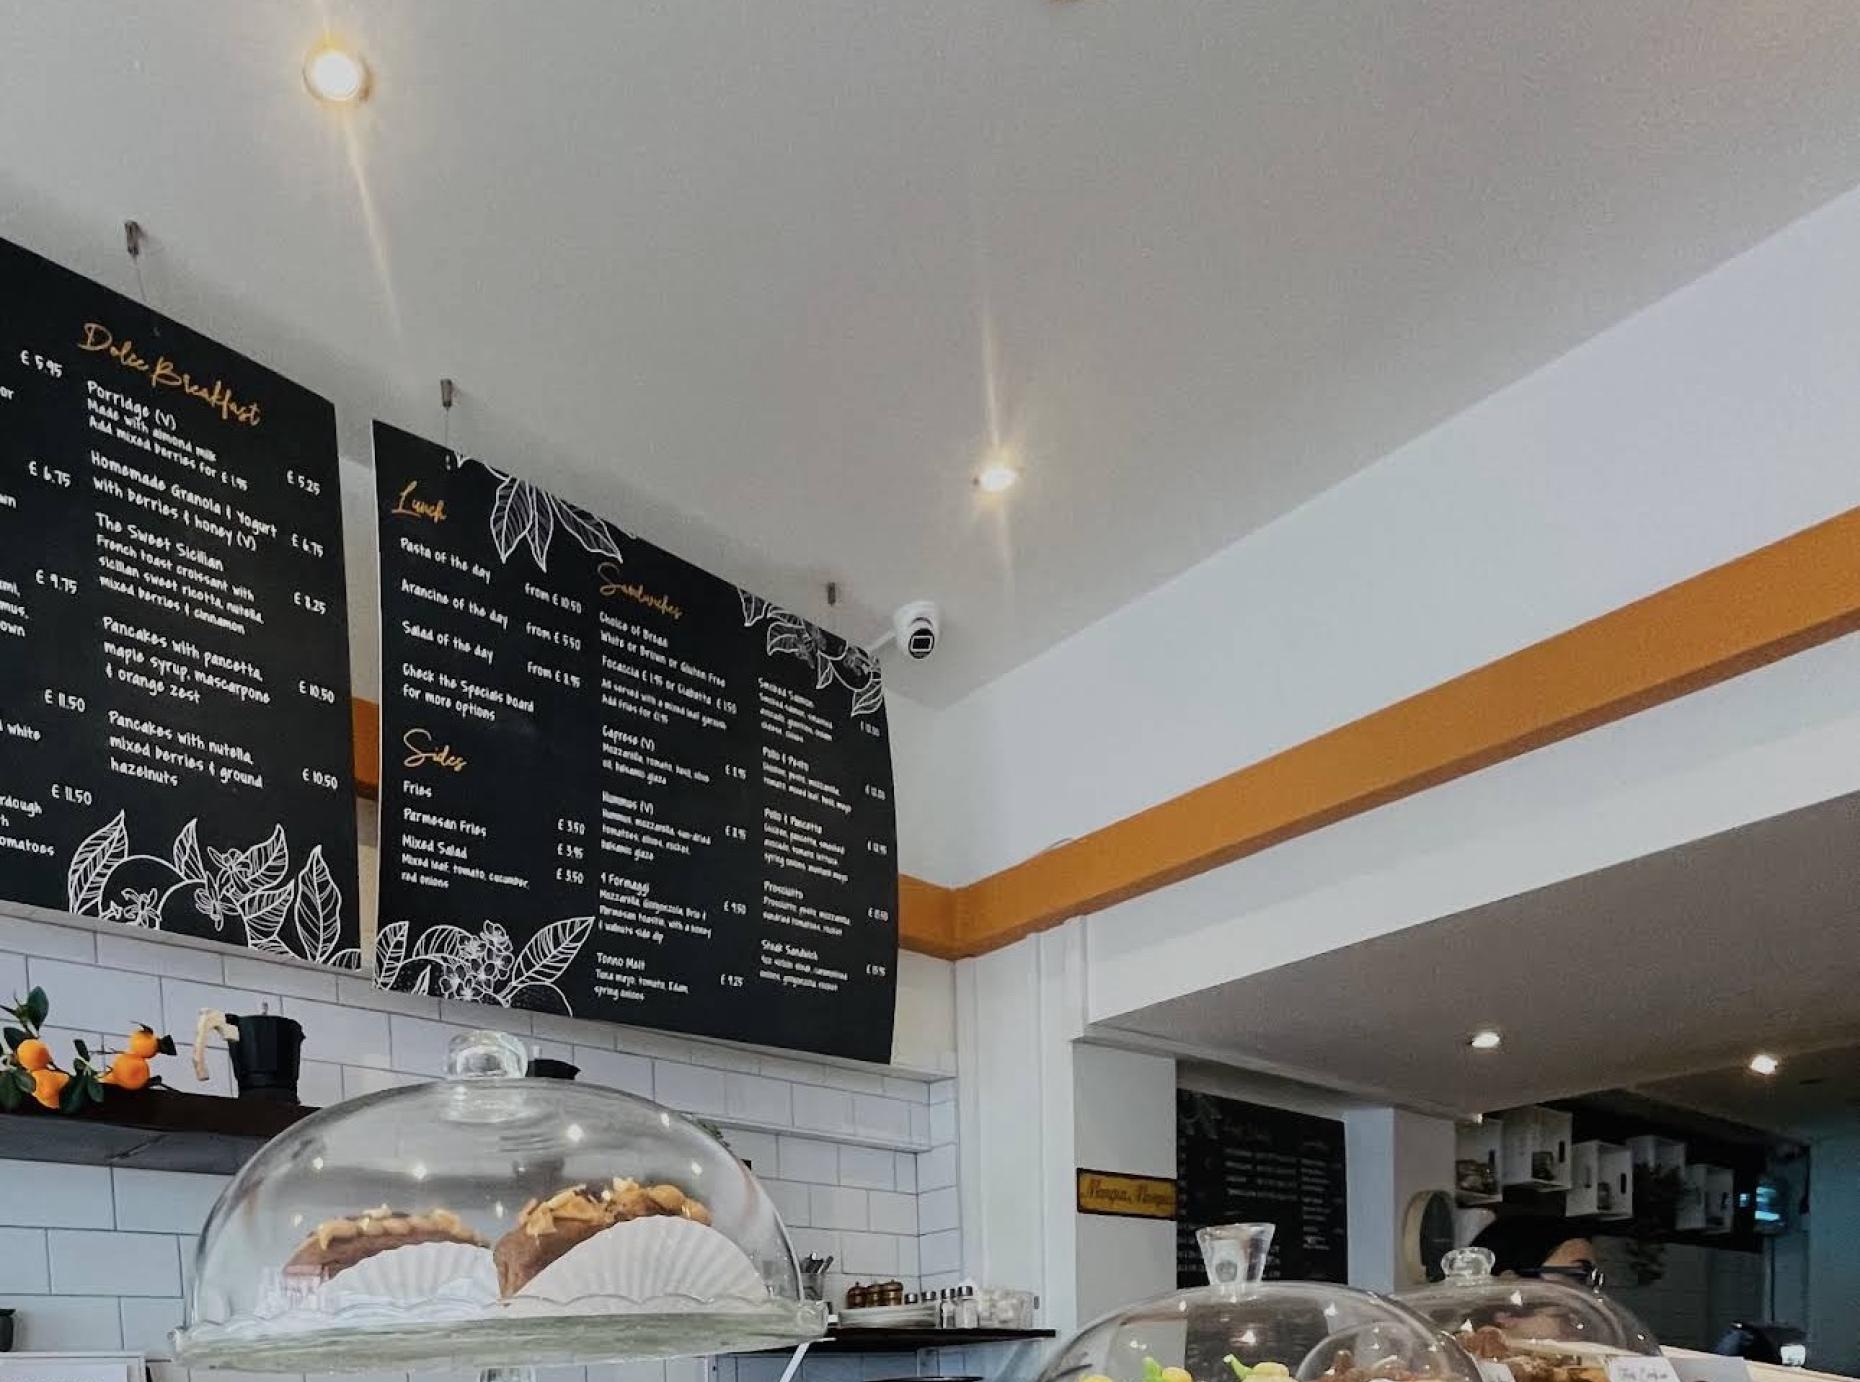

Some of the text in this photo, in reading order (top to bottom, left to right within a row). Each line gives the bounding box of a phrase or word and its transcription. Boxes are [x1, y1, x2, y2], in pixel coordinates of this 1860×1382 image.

[88, 380, 150, 422] Porridge
[91, 450, 166, 490] Homemade
[171, 484, 221, 515] Granola
[236, 511, 277, 538] Yogurt
[94, 477, 123, 498] with
[128, 488, 178, 519] berries
[194, 514, 232, 546] honey
[95, 512, 224, 571] The Sweet Sicilian
[400, 538, 431, 559] Pasta
[472, 564, 490, 584] day
[97, 534, 137, 558] French
[141, 549, 173, 570] toast
[176, 565, 228, 592] croissant
[102, 617, 167, 648] Pancakes
[172, 640, 199, 659] with
[490, 610, 508, 630] day
[402, 620, 434, 640] Salad
[474, 645, 493, 664] day
[104, 642, 144, 665] maple
[194, 670, 270, 704] mascarpone
[118, 669, 164, 696] orange
[170, 685, 200, 704] zest
[403, 663, 434, 682] Check
[439, 673, 457, 688] the
[506, 694, 534, 712] board
[425, 692, 495, 721] more options
[108, 710, 172, 740] Pancakes
[177, 732, 205, 750] with
[110, 736, 150, 757] mixed
[156, 745, 203, 771] berries
[220, 767, 262, 788] ground
[111, 757, 178, 786] hazelnuts
[404, 780, 432, 797] Fries
[404, 808, 486, 837] Parmesan Fries
[402, 834, 467, 859] Mixed Salad
